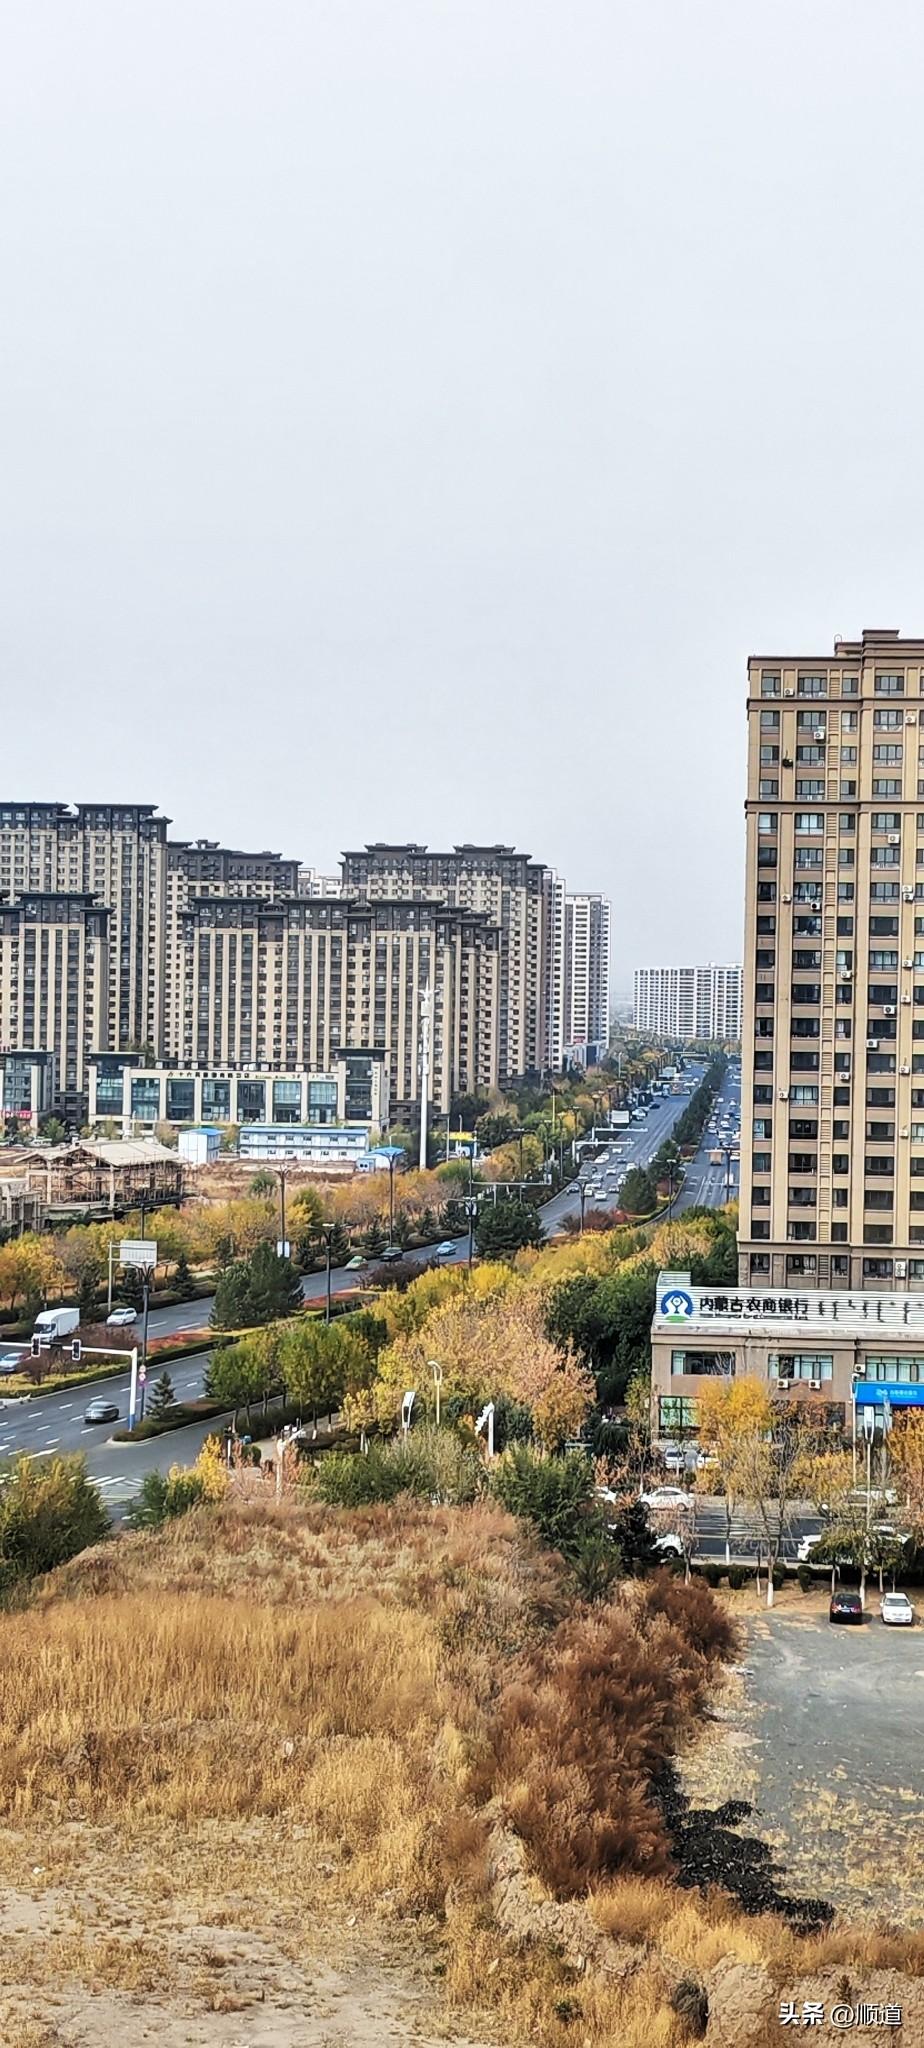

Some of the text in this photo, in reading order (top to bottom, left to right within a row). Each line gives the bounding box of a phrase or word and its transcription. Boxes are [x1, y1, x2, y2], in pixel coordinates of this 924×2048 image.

[700, 1296, 808, 1314] 内蒙古农商银行
